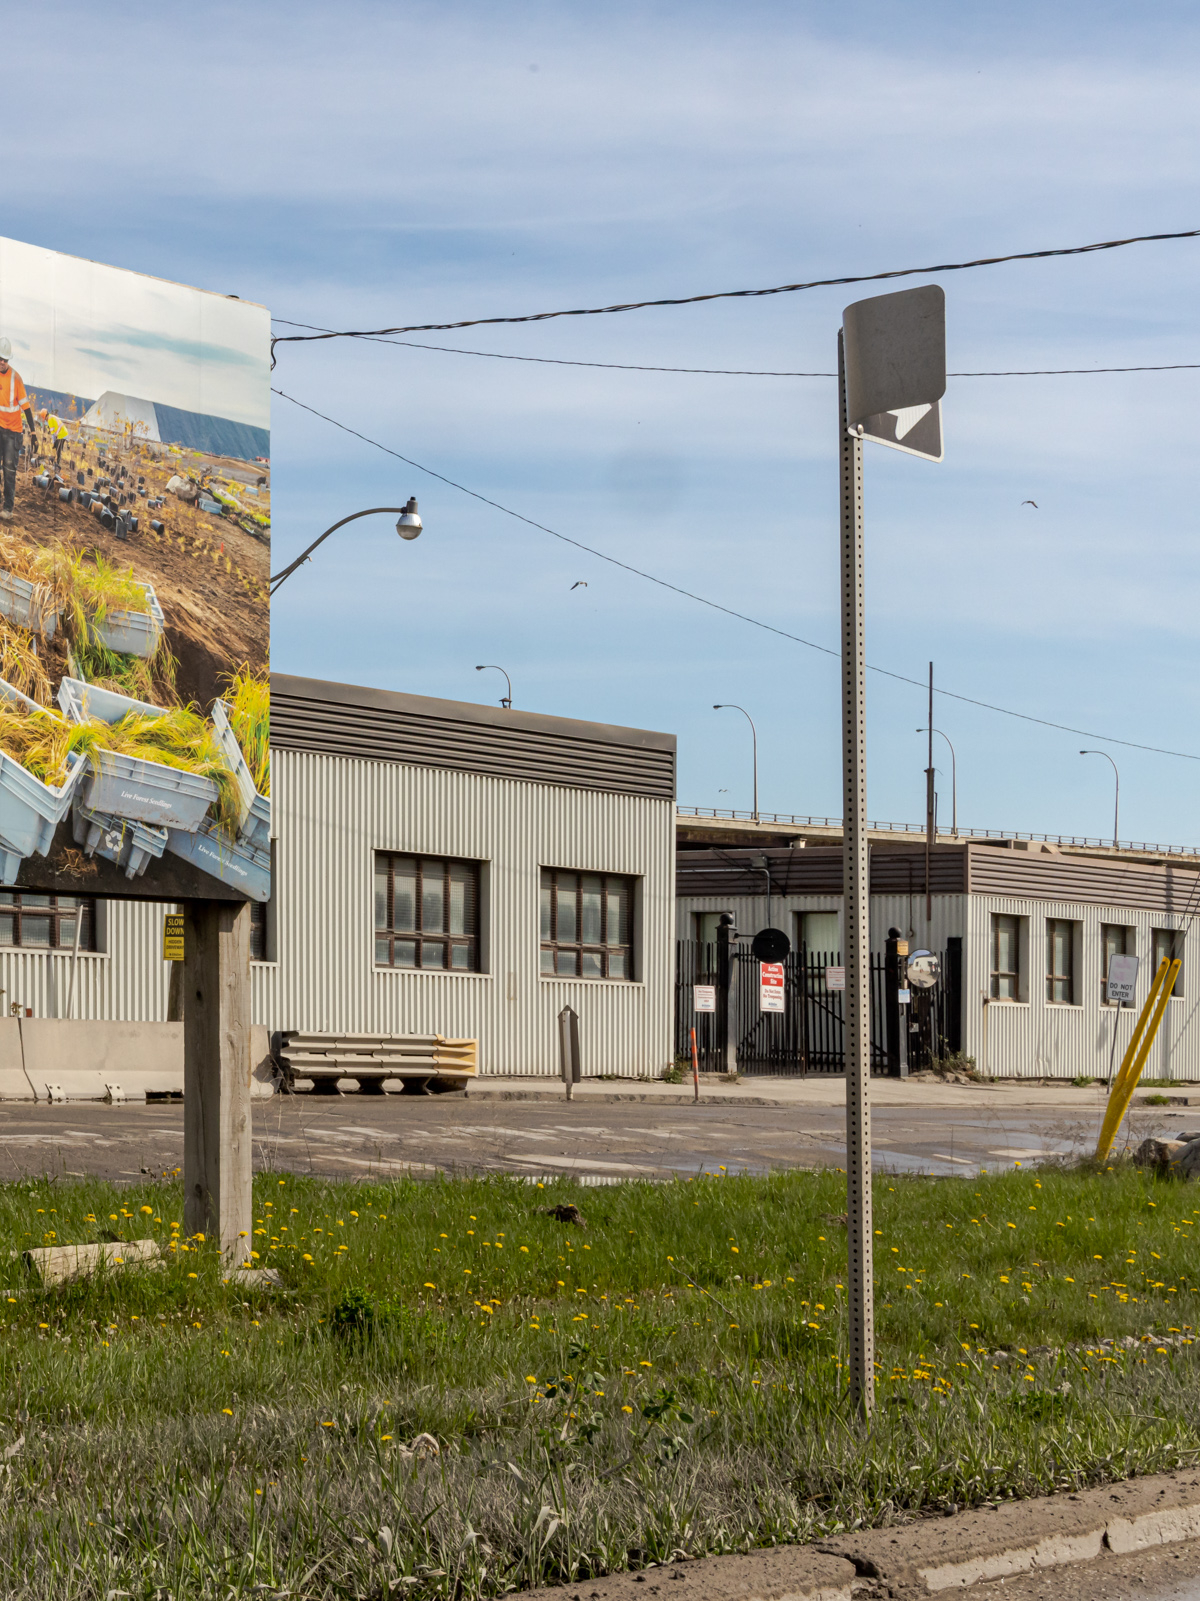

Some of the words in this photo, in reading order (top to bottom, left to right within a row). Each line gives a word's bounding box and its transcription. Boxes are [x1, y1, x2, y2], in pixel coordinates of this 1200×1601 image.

[120, 790, 132, 799] Live
[133, 793, 149, 803] Forest
[149, 798, 172, 809] Seedlings
[198, 844, 209, 854] Live
[225, 860, 248, 876] Seedlings
